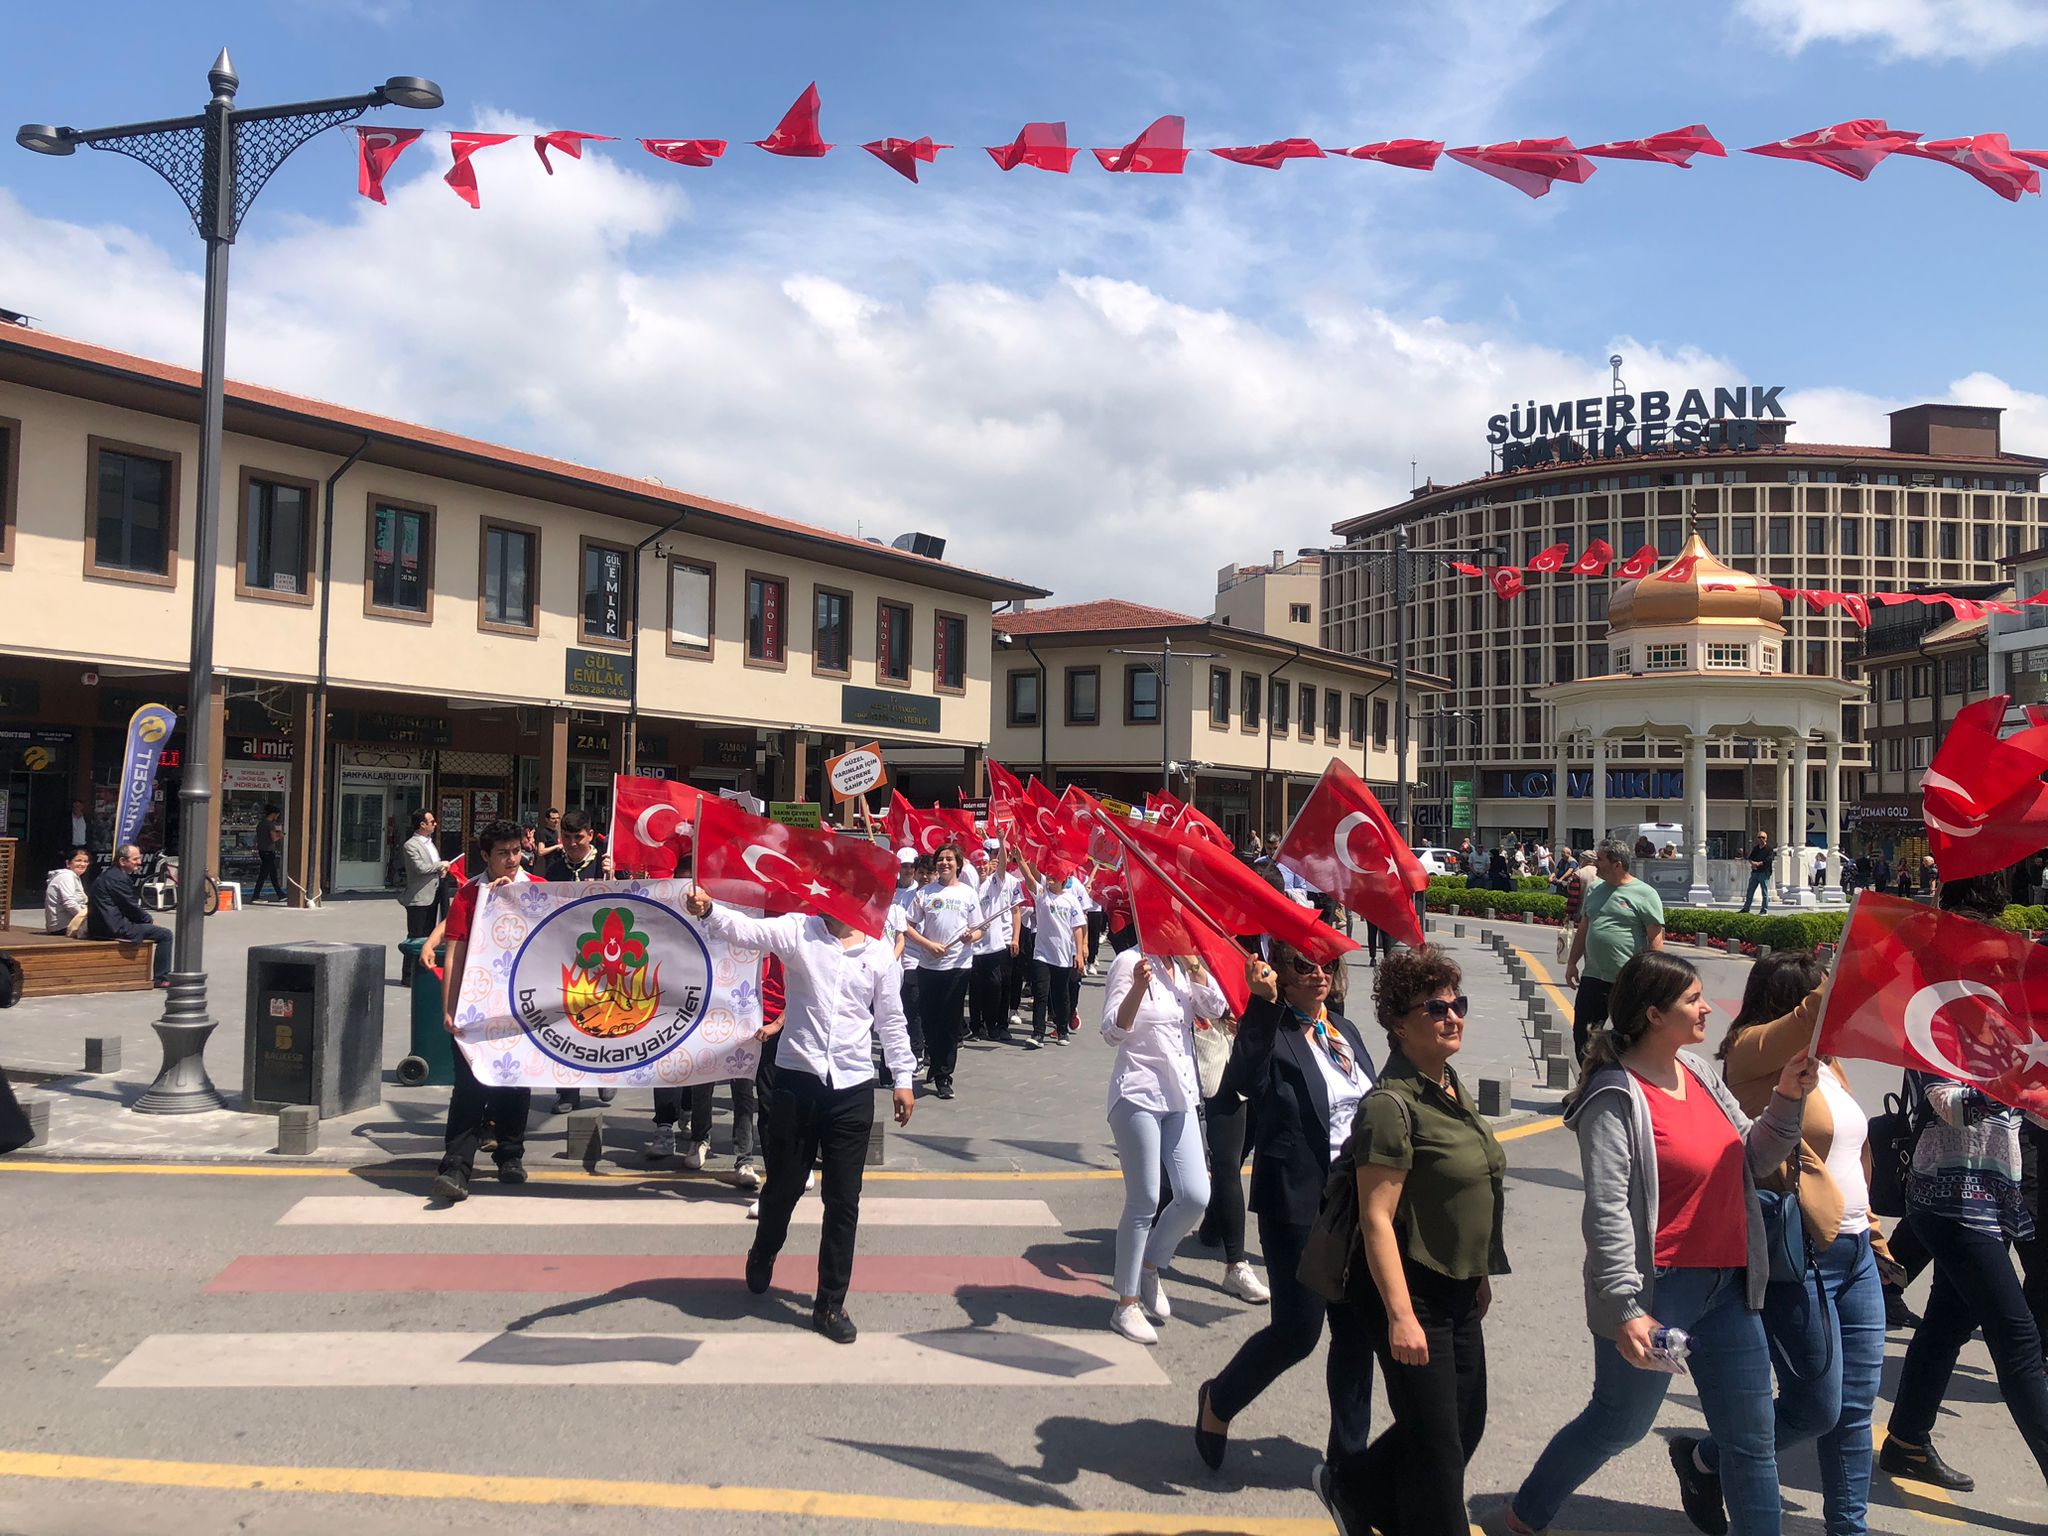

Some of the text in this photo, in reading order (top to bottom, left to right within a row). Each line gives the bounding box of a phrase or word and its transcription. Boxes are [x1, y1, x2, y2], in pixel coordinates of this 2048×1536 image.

[1486, 386, 1786, 444] SÜMERBANK
[1503, 419, 1759, 473] BALIKESİR
[606, 555, 620, 565] GÜL
[606, 567, 618, 634] EMLAK
[766, 599, 775, 658] NOTER
[879, 620, 888, 676] NOTER
[584, 654, 614, 670] GÜL
[574, 667, 624, 687] EMLAK
[834, 758, 878, 779] YARINLAR İÇİN
[844, 756, 864, 767] GÜZEL
[636, 766, 666, 779] ASIO
[843, 769, 872, 784] ÇEVRENE
[863, 776, 875, 785] ÇIK
[122, 749, 153, 841] TURKCELL
[1860, 807, 1886, 817] UZMAN
[1887, 806, 1908, 817] GOLD
